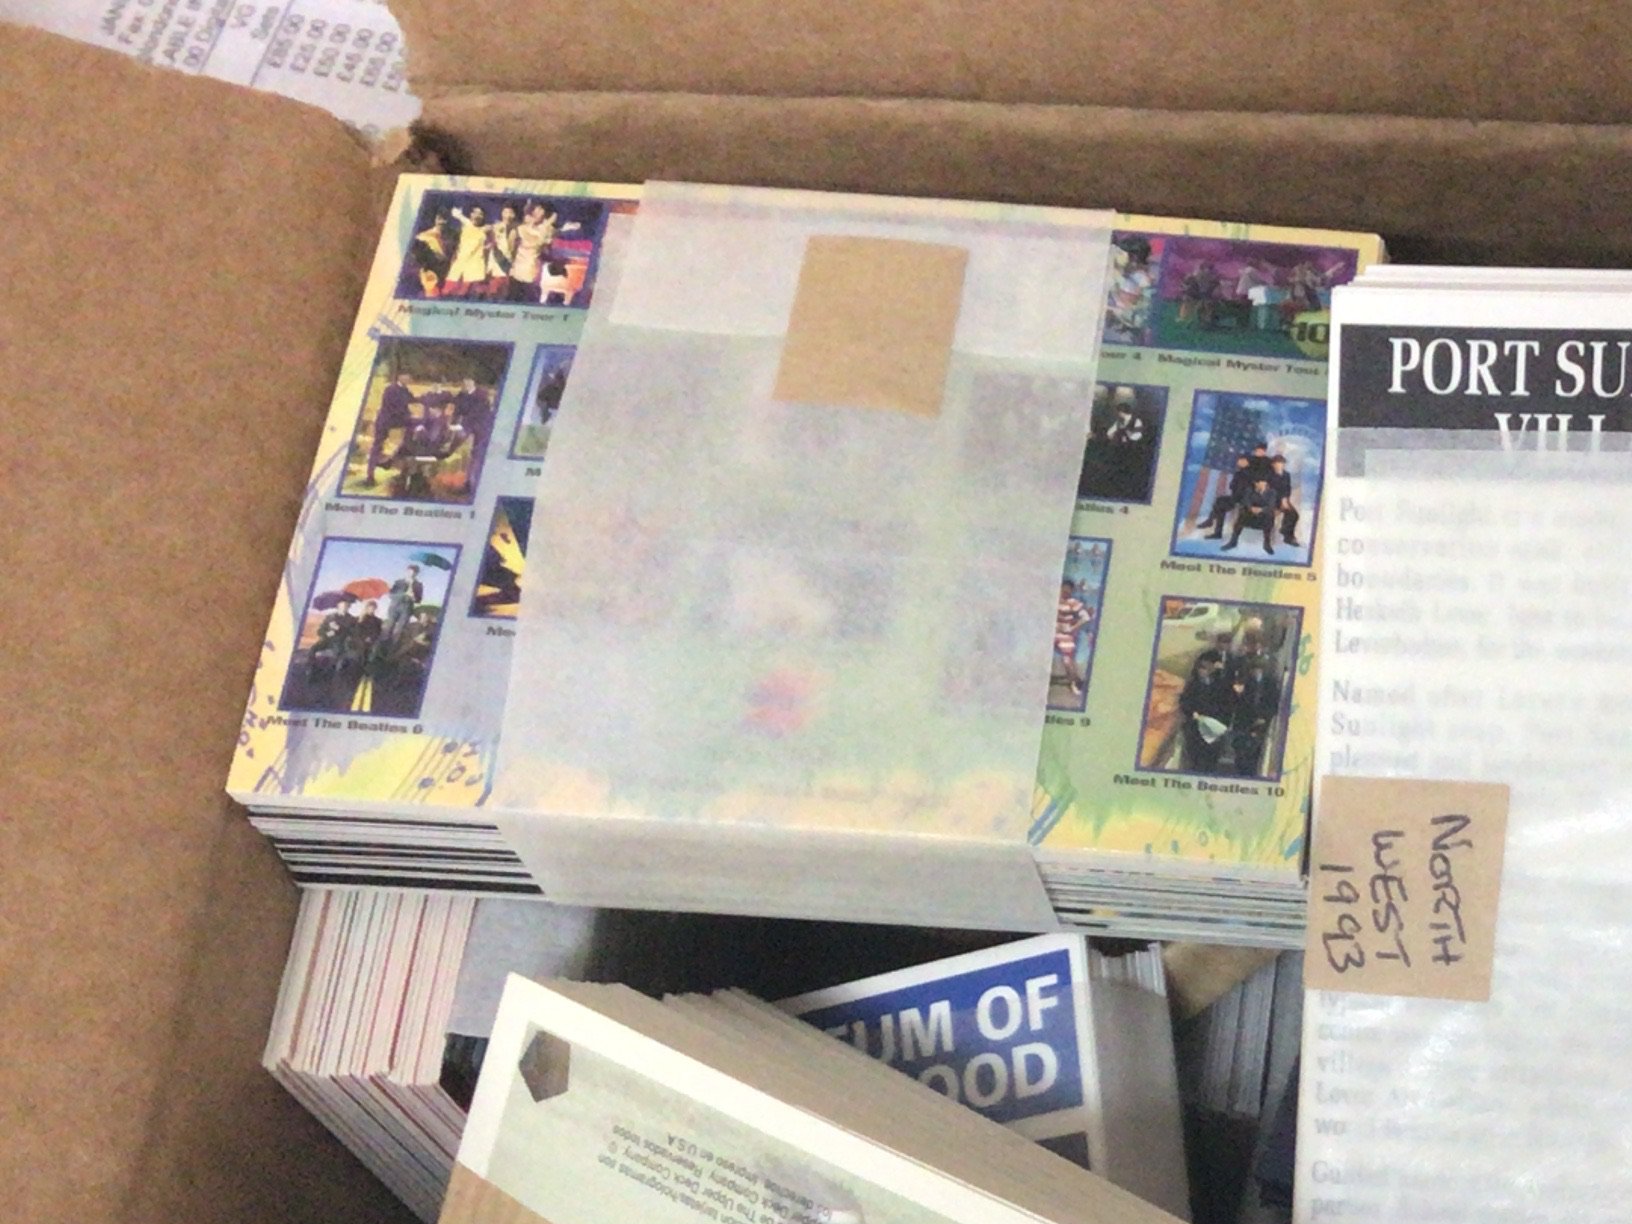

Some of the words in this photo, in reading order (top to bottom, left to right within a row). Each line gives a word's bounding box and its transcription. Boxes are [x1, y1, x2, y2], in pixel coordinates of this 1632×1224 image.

[1387, 335, 1540, 397] PORT
[325, 502, 365, 515] Meet
[372, 504, 398, 516] The
[404, 506, 463, 520] Beatles
[1160, 560, 1202, 573] Meet
[1208, 563, 1236, 577] The
[1242, 566, 1302, 582] Beatles
[267, 715, 308, 729] Meet
[314, 718, 341, 730] The
[347, 721, 407, 735] Beatles
[1113, 774, 1155, 787] Meet
[1163, 777, 1191, 790] The
[1197, 780, 1259, 797] Beatles
[1265, 785, 1285, 798] 10
[1319, 864, 1365, 974] 1993
[1369, 829, 1411, 968] WEST
[976, 973, 1058, 1041] OF
